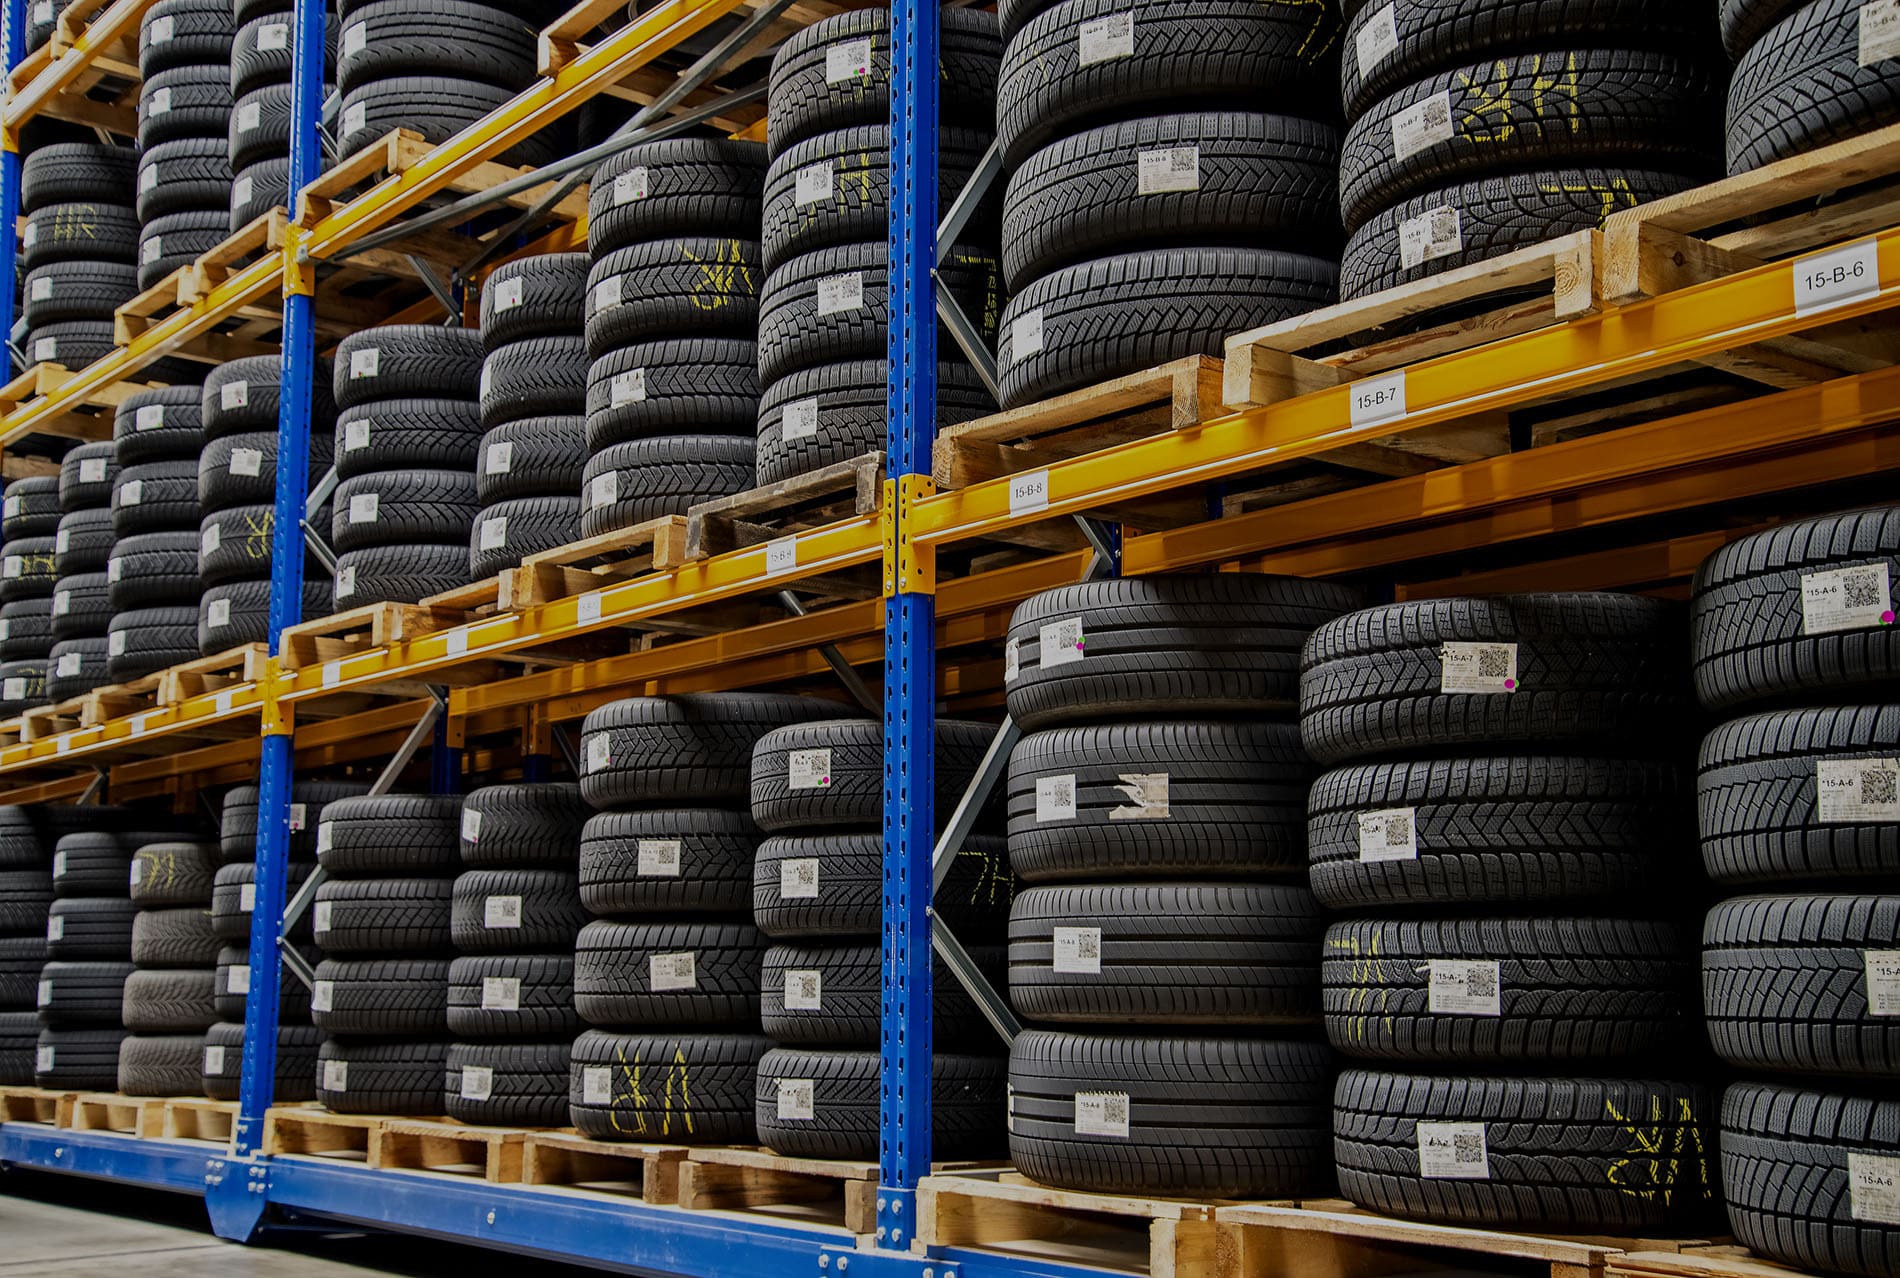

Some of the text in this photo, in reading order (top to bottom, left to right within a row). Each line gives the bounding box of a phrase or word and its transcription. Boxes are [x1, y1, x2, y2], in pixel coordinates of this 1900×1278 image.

[1805, 260, 1864, 291] 15-B-6
[1357, 388, 1397, 410] 15-B-7
[1015, 482, 1042, 498] 15-B-8
